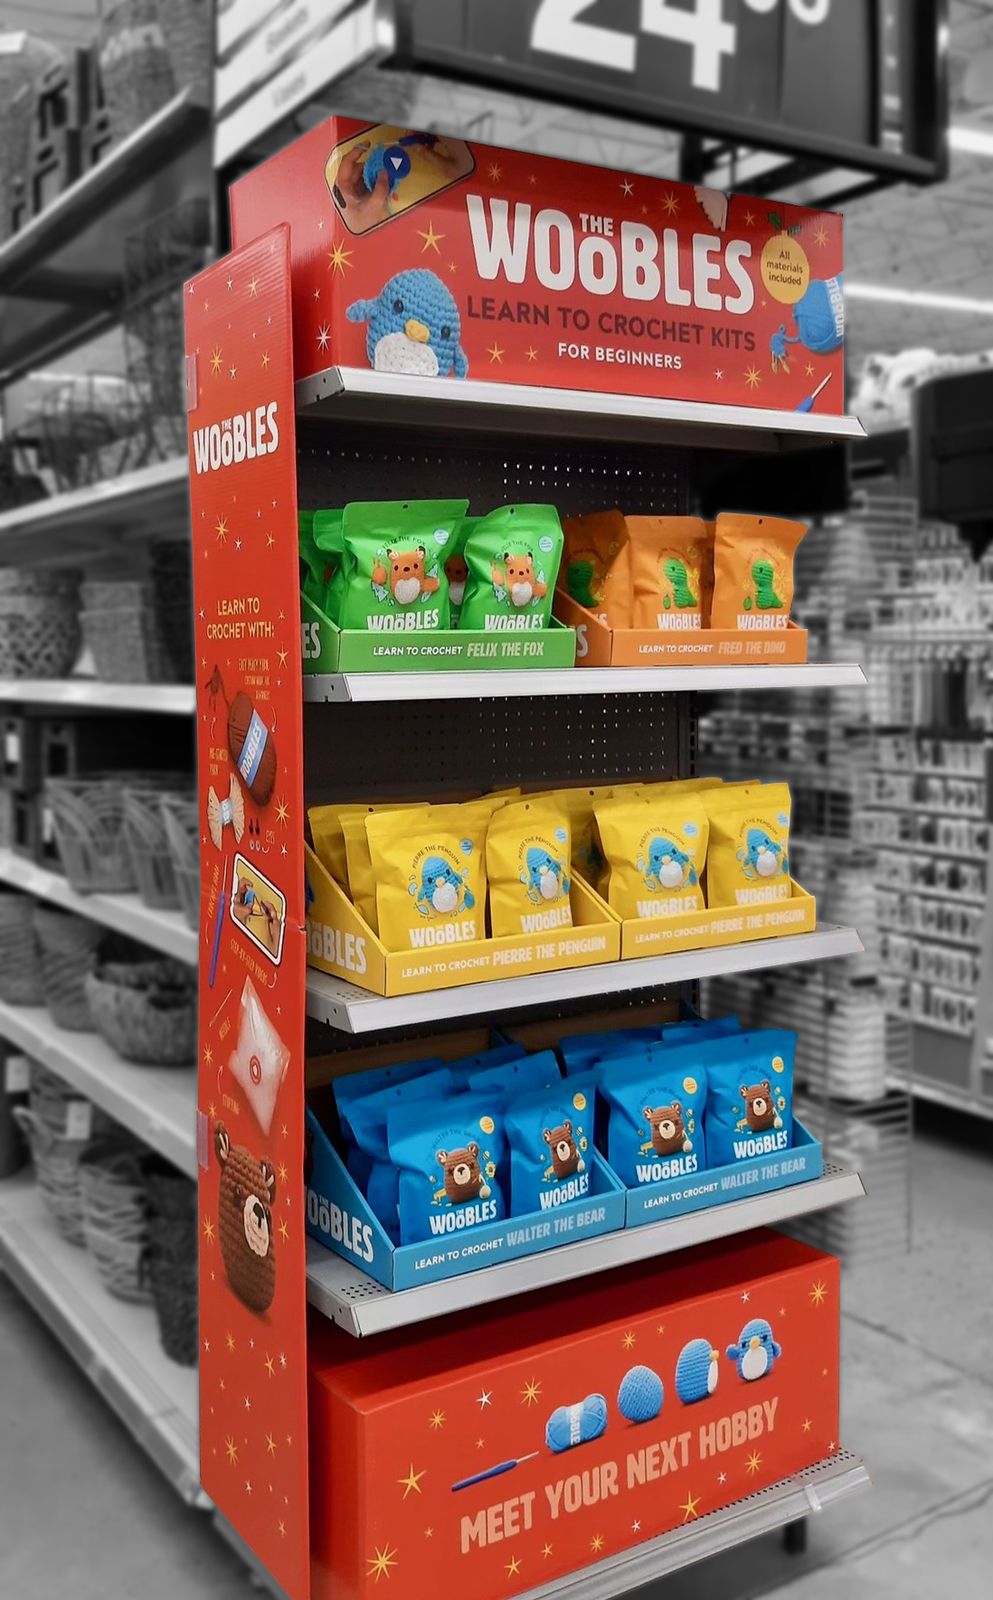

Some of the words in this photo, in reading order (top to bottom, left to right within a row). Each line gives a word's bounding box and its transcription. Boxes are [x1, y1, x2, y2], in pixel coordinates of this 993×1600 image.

[579, 213, 614, 236] THE
[466, 194, 755, 315] WOOBLES
[767, 260, 803, 274] materials
[780, 250, 790, 260] All
[769, 272, 801, 286] included
[467, 295, 550, 326] LEARN
[557, 307, 590, 331] TO
[598, 312, 704, 344] CROCHET
[711, 327, 756, 351] KITS
[558, 343, 589, 360] FOR
[595, 347, 682, 369] BEGINNERS
[193, 401, 279, 474] WOOBLES
[221, 417, 232, 432] THE
[217, 599, 245, 616] LEARN
[248, 597, 260, 614] TO
[367, 608, 439, 631] WOOBLES
[207, 622, 245, 639] CROCHET
[248, 621, 275, 638] WITH:
[373, 646, 403, 656] LEARN
[406, 646, 419, 655] TO
[420, 646, 463, 655] CROCHET
[467, 642, 498, 657] FELIX
[501, 642, 521, 657] THE
[523, 641, 544, 656] FOX
[639, 645, 664, 654] LEARN
[666, 644, 677, 653] TO
[678, 644, 714, 653] CROCHET
[718, 641, 743, 655] FRED
[745, 641, 762, 655] THE
[437, 845, 460, 865] PENGUIN
[409, 920, 476, 949] WOOBLES
[635, 934, 660, 944] LEARN
[662, 930, 673, 939] TO
[674, 924, 708, 938] CROCHET
[710, 917, 743, 934] PIERRE
[746, 914, 763, 929] THE
[765, 909, 806, 926] PENGUIN
[401, 966, 432, 978] LEARN
[434, 964, 447, 972] TO
[449, 956, 490, 971] CROCHET
[492, 946, 533, 966] PIERRE
[536, 944, 556, 960] THE
[558, 936, 606, 956] PENGUIN
[733, 1130, 788, 1159] WOOBLES
[636, 1153, 698, 1183] WOOBLES
[539, 1172, 589, 1211] WOOBLES
[643, 1198, 669, 1209] LEARN
[671, 1193, 682, 1201] TO
[682, 1182, 719, 1198] CROCHET
[720, 1171, 758, 1190] WALTER
[761, 1165, 779, 1180] THE
[781, 1157, 806, 1176] BEAR
[307, 1189, 374, 1263] OOBLES
[429, 1199, 497, 1235] WOOBLES
[414, 1256, 445, 1270] LEARN
[447, 1251, 459, 1260] TO
[461, 1238, 503, 1257] CROCHET
[506, 1224, 550, 1247] WALTER
[554, 1218, 574, 1233] THE
[576, 1207, 606, 1226] BEAR
[460, 1492, 536, 1554] MEET
[545, 1460, 619, 1520] YOUR
[626, 1431, 692, 1490] NEXT
[699, 1397, 779, 1460] HOBBY
